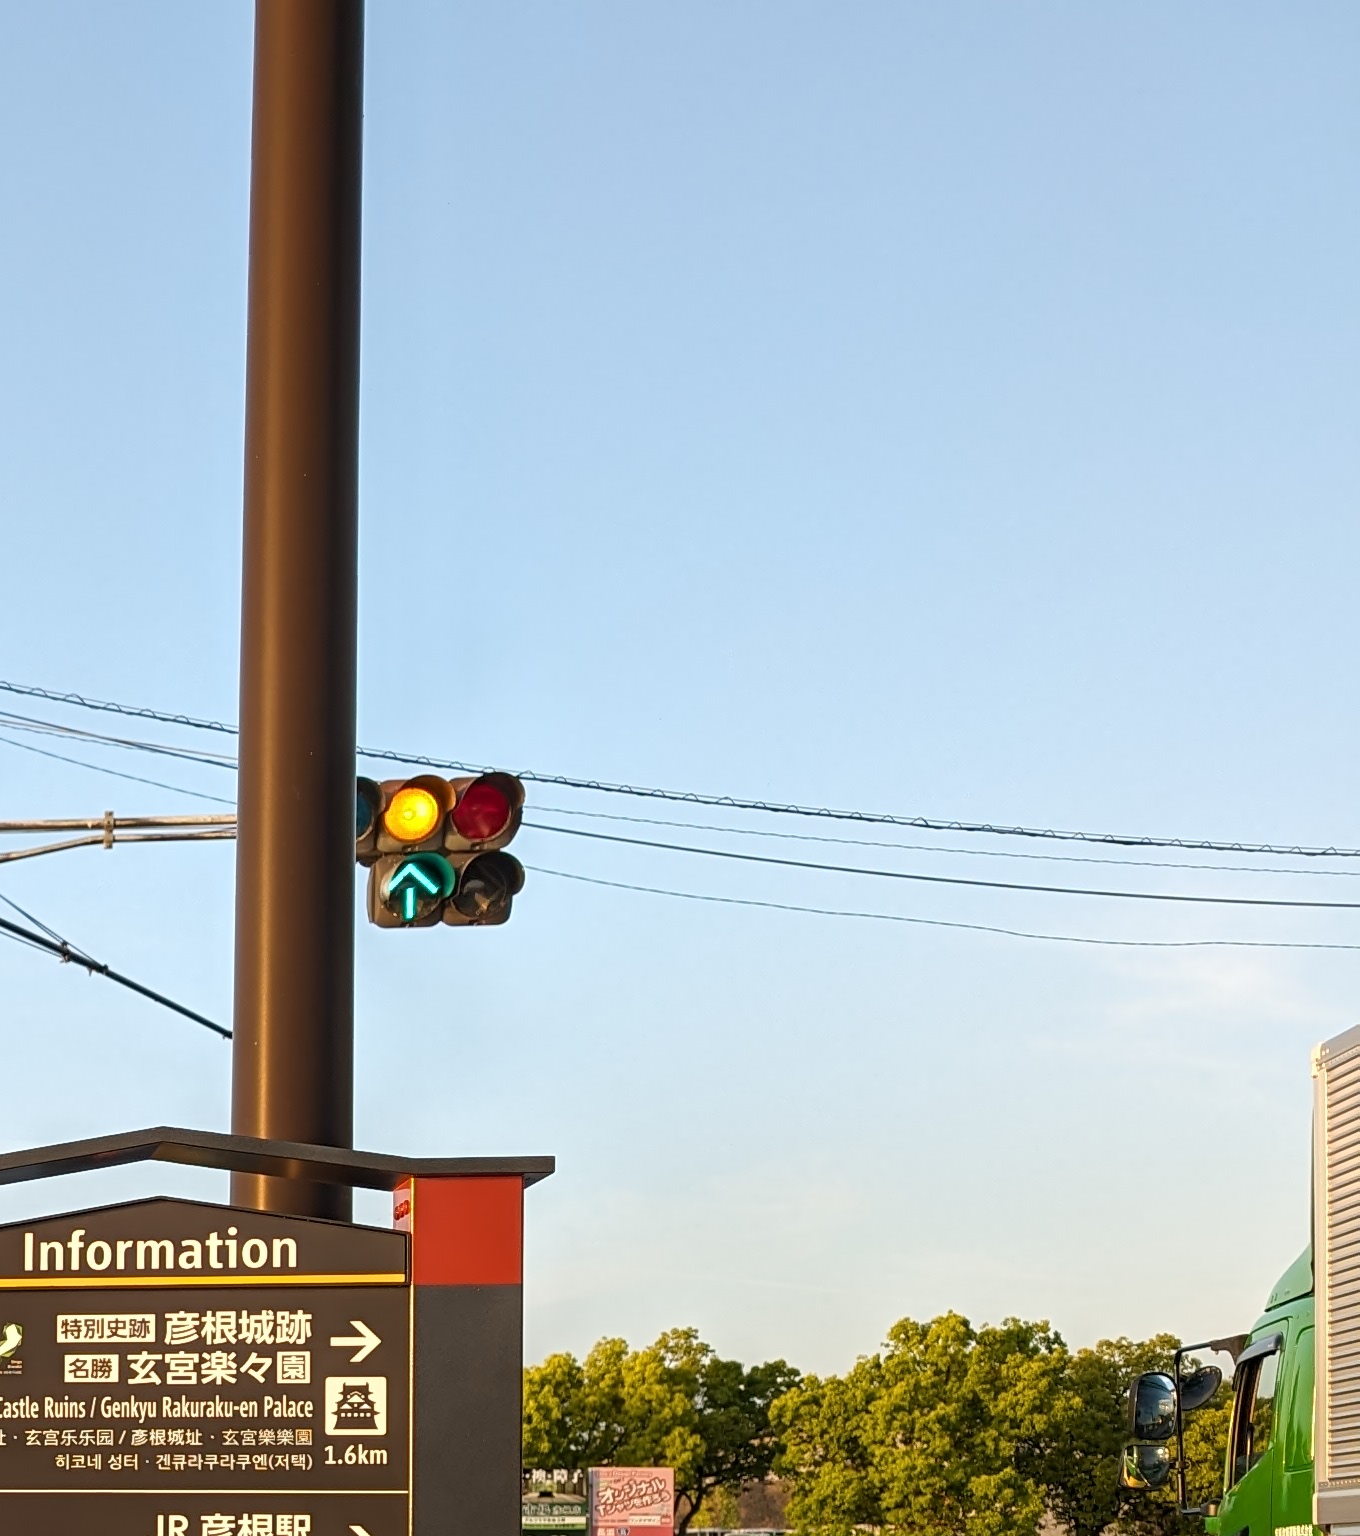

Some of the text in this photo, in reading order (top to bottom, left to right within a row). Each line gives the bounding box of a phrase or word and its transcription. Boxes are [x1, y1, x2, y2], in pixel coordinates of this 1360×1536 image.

[24, 1226, 297, 1272] Information
[60, 1309, 313, 1346] 特別史跡 彦根城跡
[67, 1350, 311, 1386] 名勝 玄宮楽々園
[44, 1395, 86, 1419] Ruins
[100, 1394, 157, 1424] Genkyu
[162, 1394, 258, 1418] Rakuraku-en
[263, 1394, 314, 1418] Palace
[54, 1453, 313, 1471] 히코네 성터 겐큐라쿠라쿠엔(저택)
[324, 1443, 388, 1465] 1.6km
